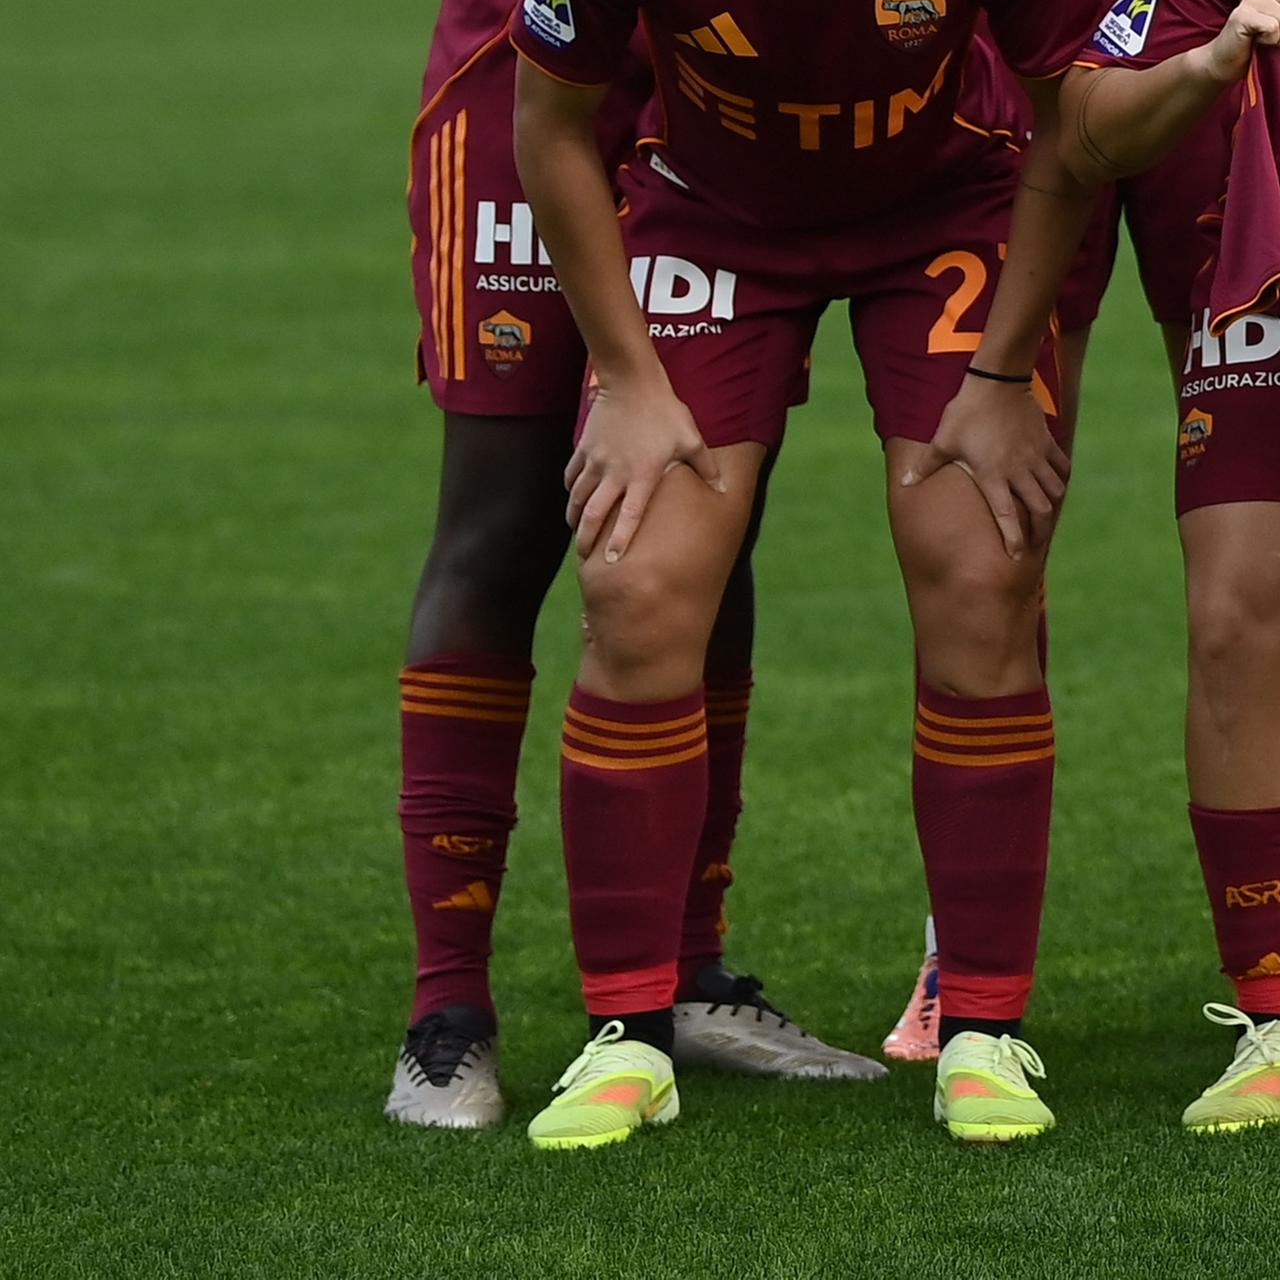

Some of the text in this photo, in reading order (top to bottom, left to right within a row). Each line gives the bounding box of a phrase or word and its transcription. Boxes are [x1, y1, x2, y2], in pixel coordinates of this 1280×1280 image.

[887, 24, 937, 41] ROMA
[778, 50, 952, 150] TIM
[475, 274, 562, 293] ASSICUR
